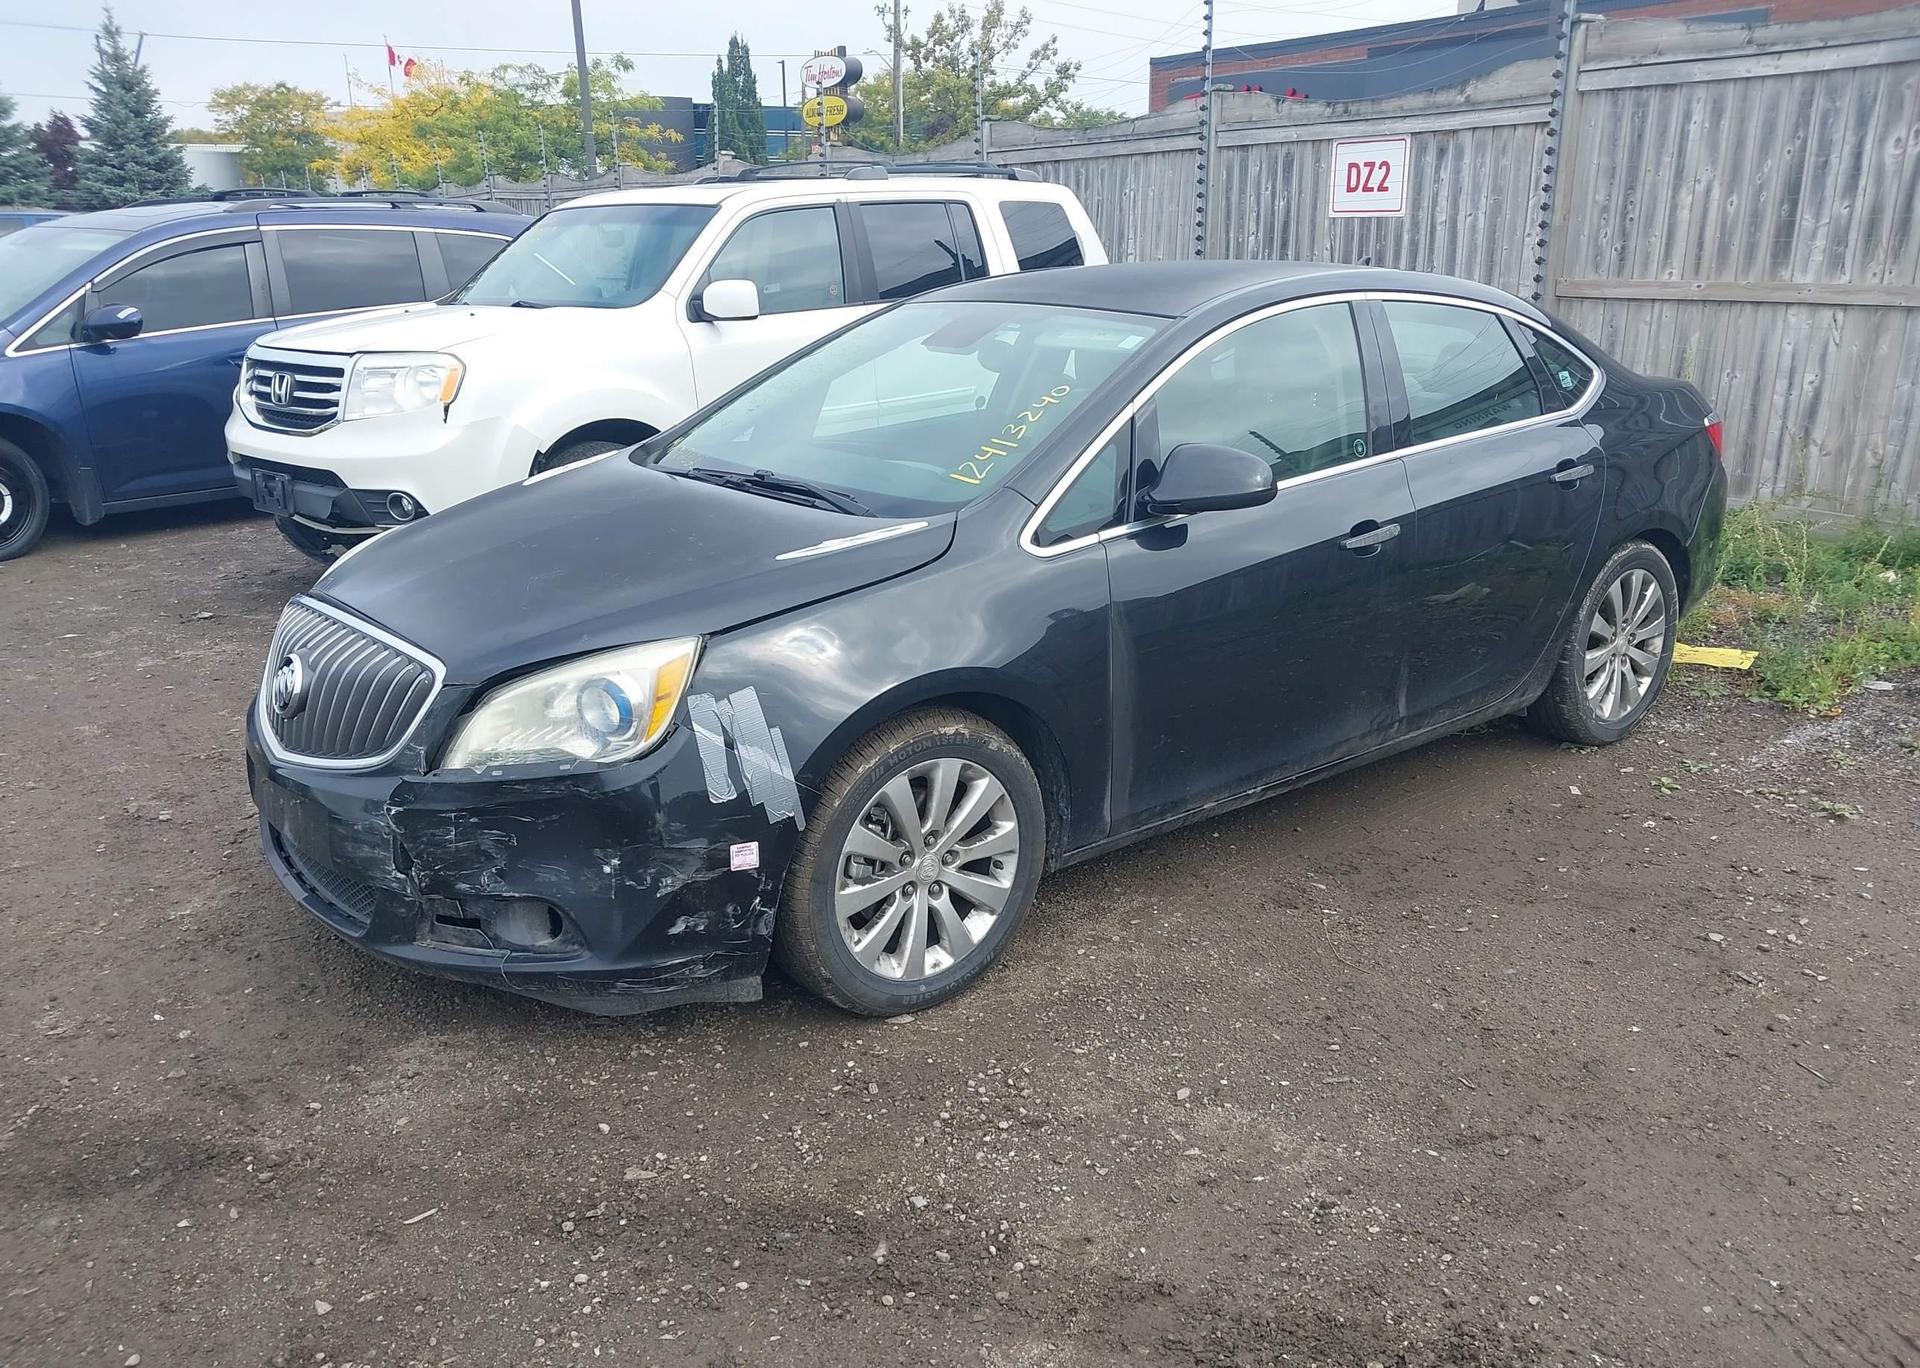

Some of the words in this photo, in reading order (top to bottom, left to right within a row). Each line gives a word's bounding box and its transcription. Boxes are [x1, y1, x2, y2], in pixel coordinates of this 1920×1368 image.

[804, 65, 818, 83] Tim
[818, 63, 843, 82] Hortons
[826, 104, 844, 116] FRESH
[1346, 161, 1391, 193] DZ2
[949, 385, 1071, 484] 12413240
